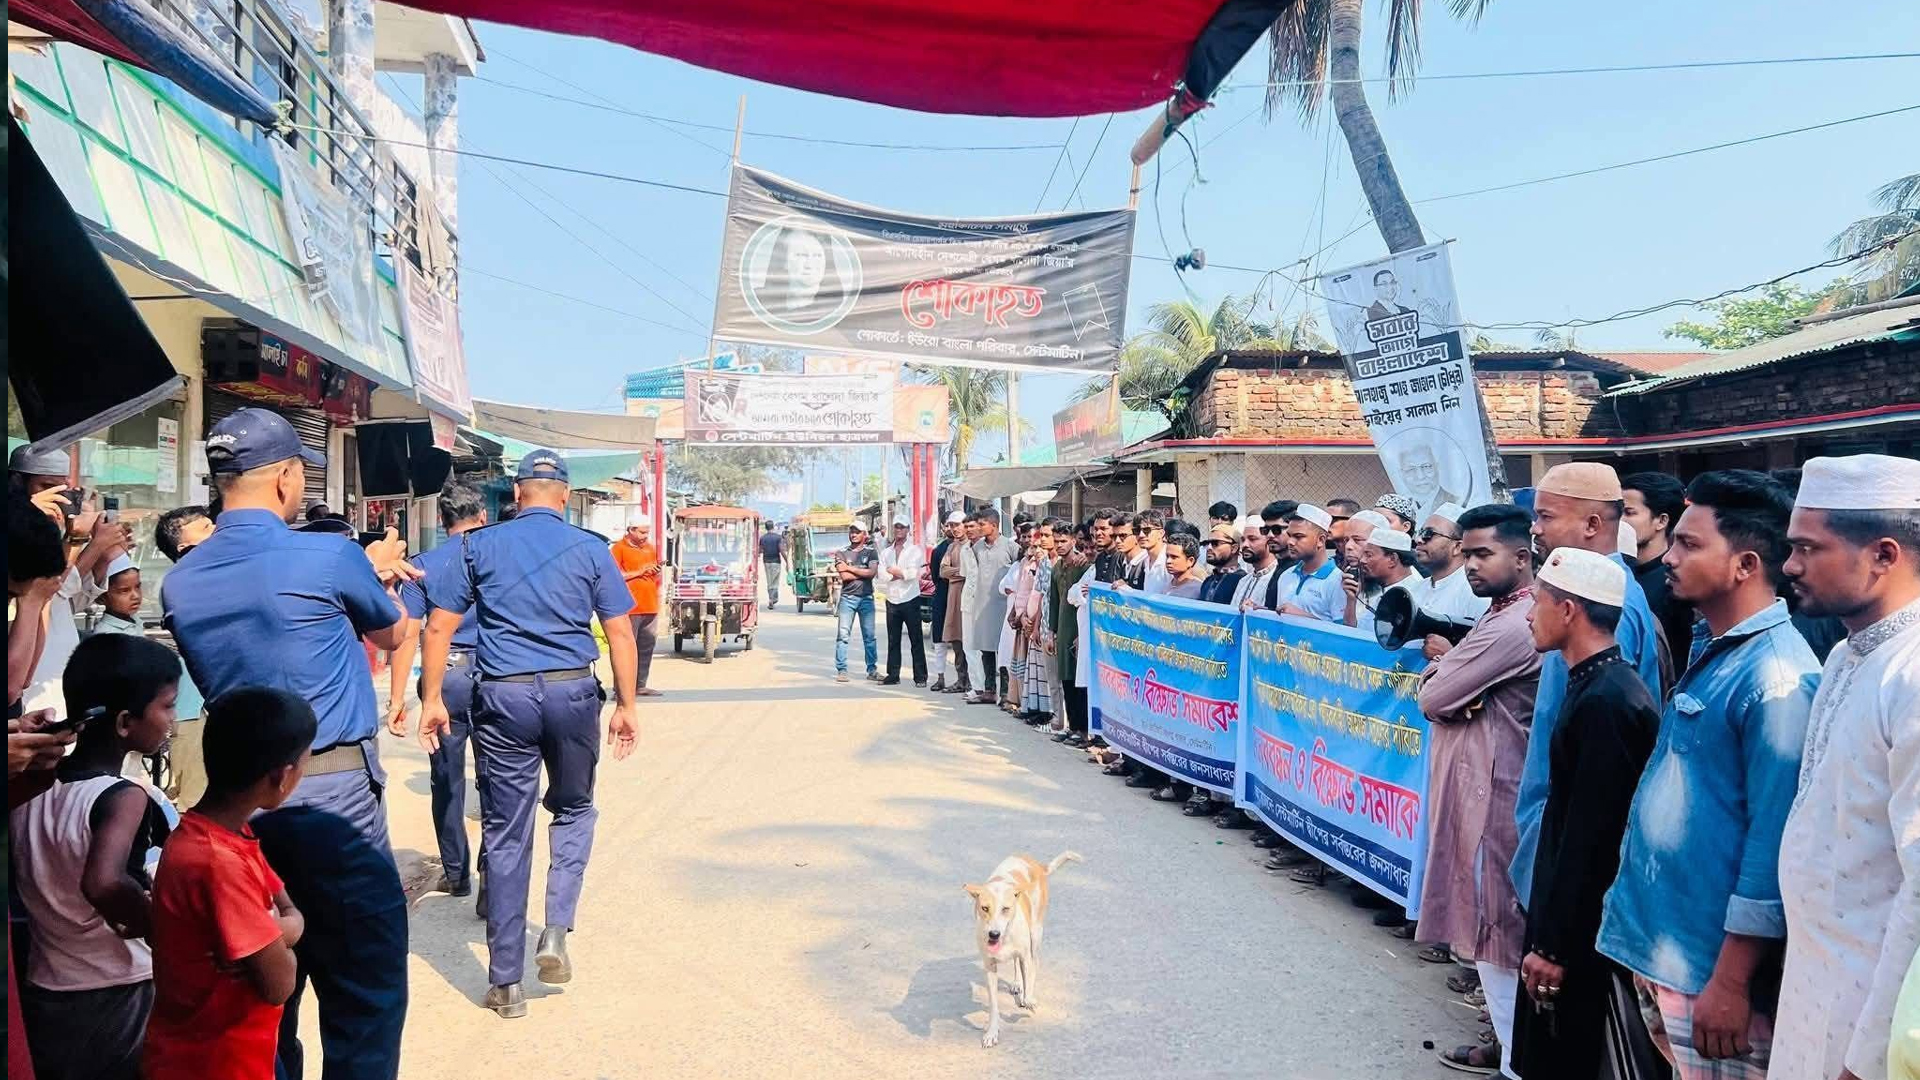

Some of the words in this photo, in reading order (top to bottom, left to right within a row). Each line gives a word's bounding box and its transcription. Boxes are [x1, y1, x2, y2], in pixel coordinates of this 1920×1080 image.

[901, 279, 1046, 328] শোকাহত
[1369, 313, 1418, 339] সবার
[942, 336, 974, 352] বাংলা
[1378, 334, 1417, 354] আগে
[1356, 344, 1448, 376] বাংলাদেশ
[1409, 374, 1437, 394] জাহান
[1437, 363, 1465, 392] চৌধুরী
[1405, 401, 1439, 419] সালাম
[1440, 394, 1461, 412] নিন
[1294, 749, 1306, 791] ও
[1358, 775, 1420, 841] সমাবে
[1367, 851, 1411, 889] জনসাধার
